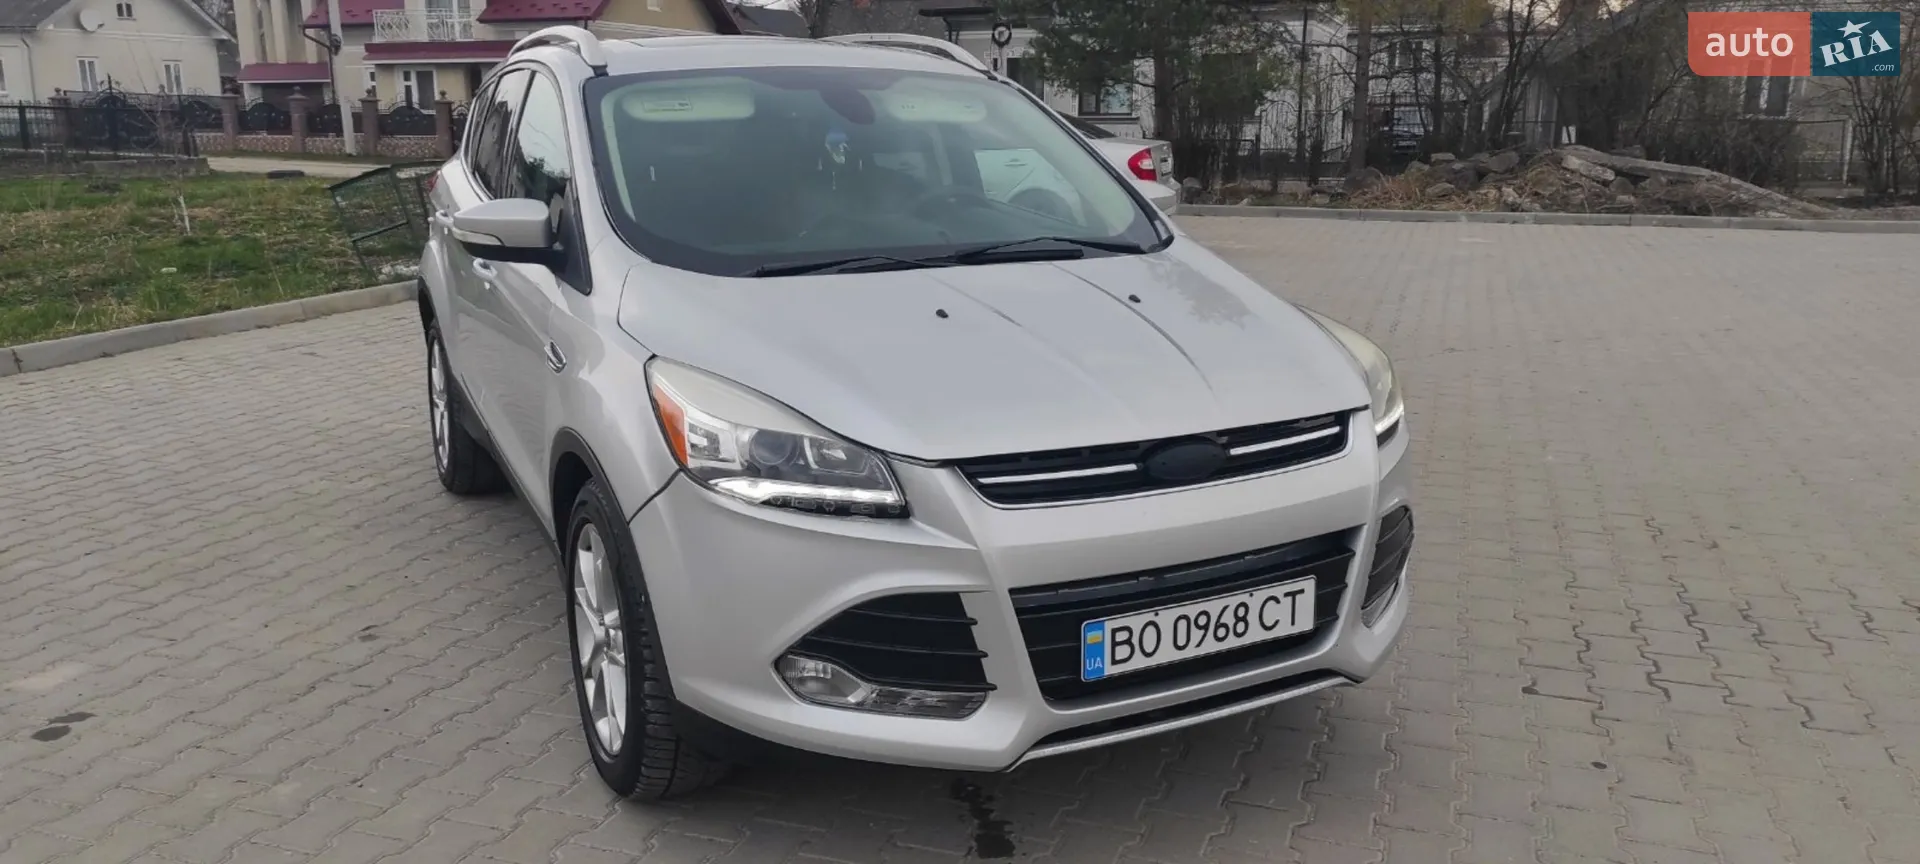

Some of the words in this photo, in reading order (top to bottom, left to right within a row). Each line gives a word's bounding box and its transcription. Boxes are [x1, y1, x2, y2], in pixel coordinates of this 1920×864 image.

[1110, 620, 1162, 666] BO
[1172, 602, 1250, 651] 0968
[1258, 588, 1305, 632] CT
[1086, 657, 1103, 670] UA
